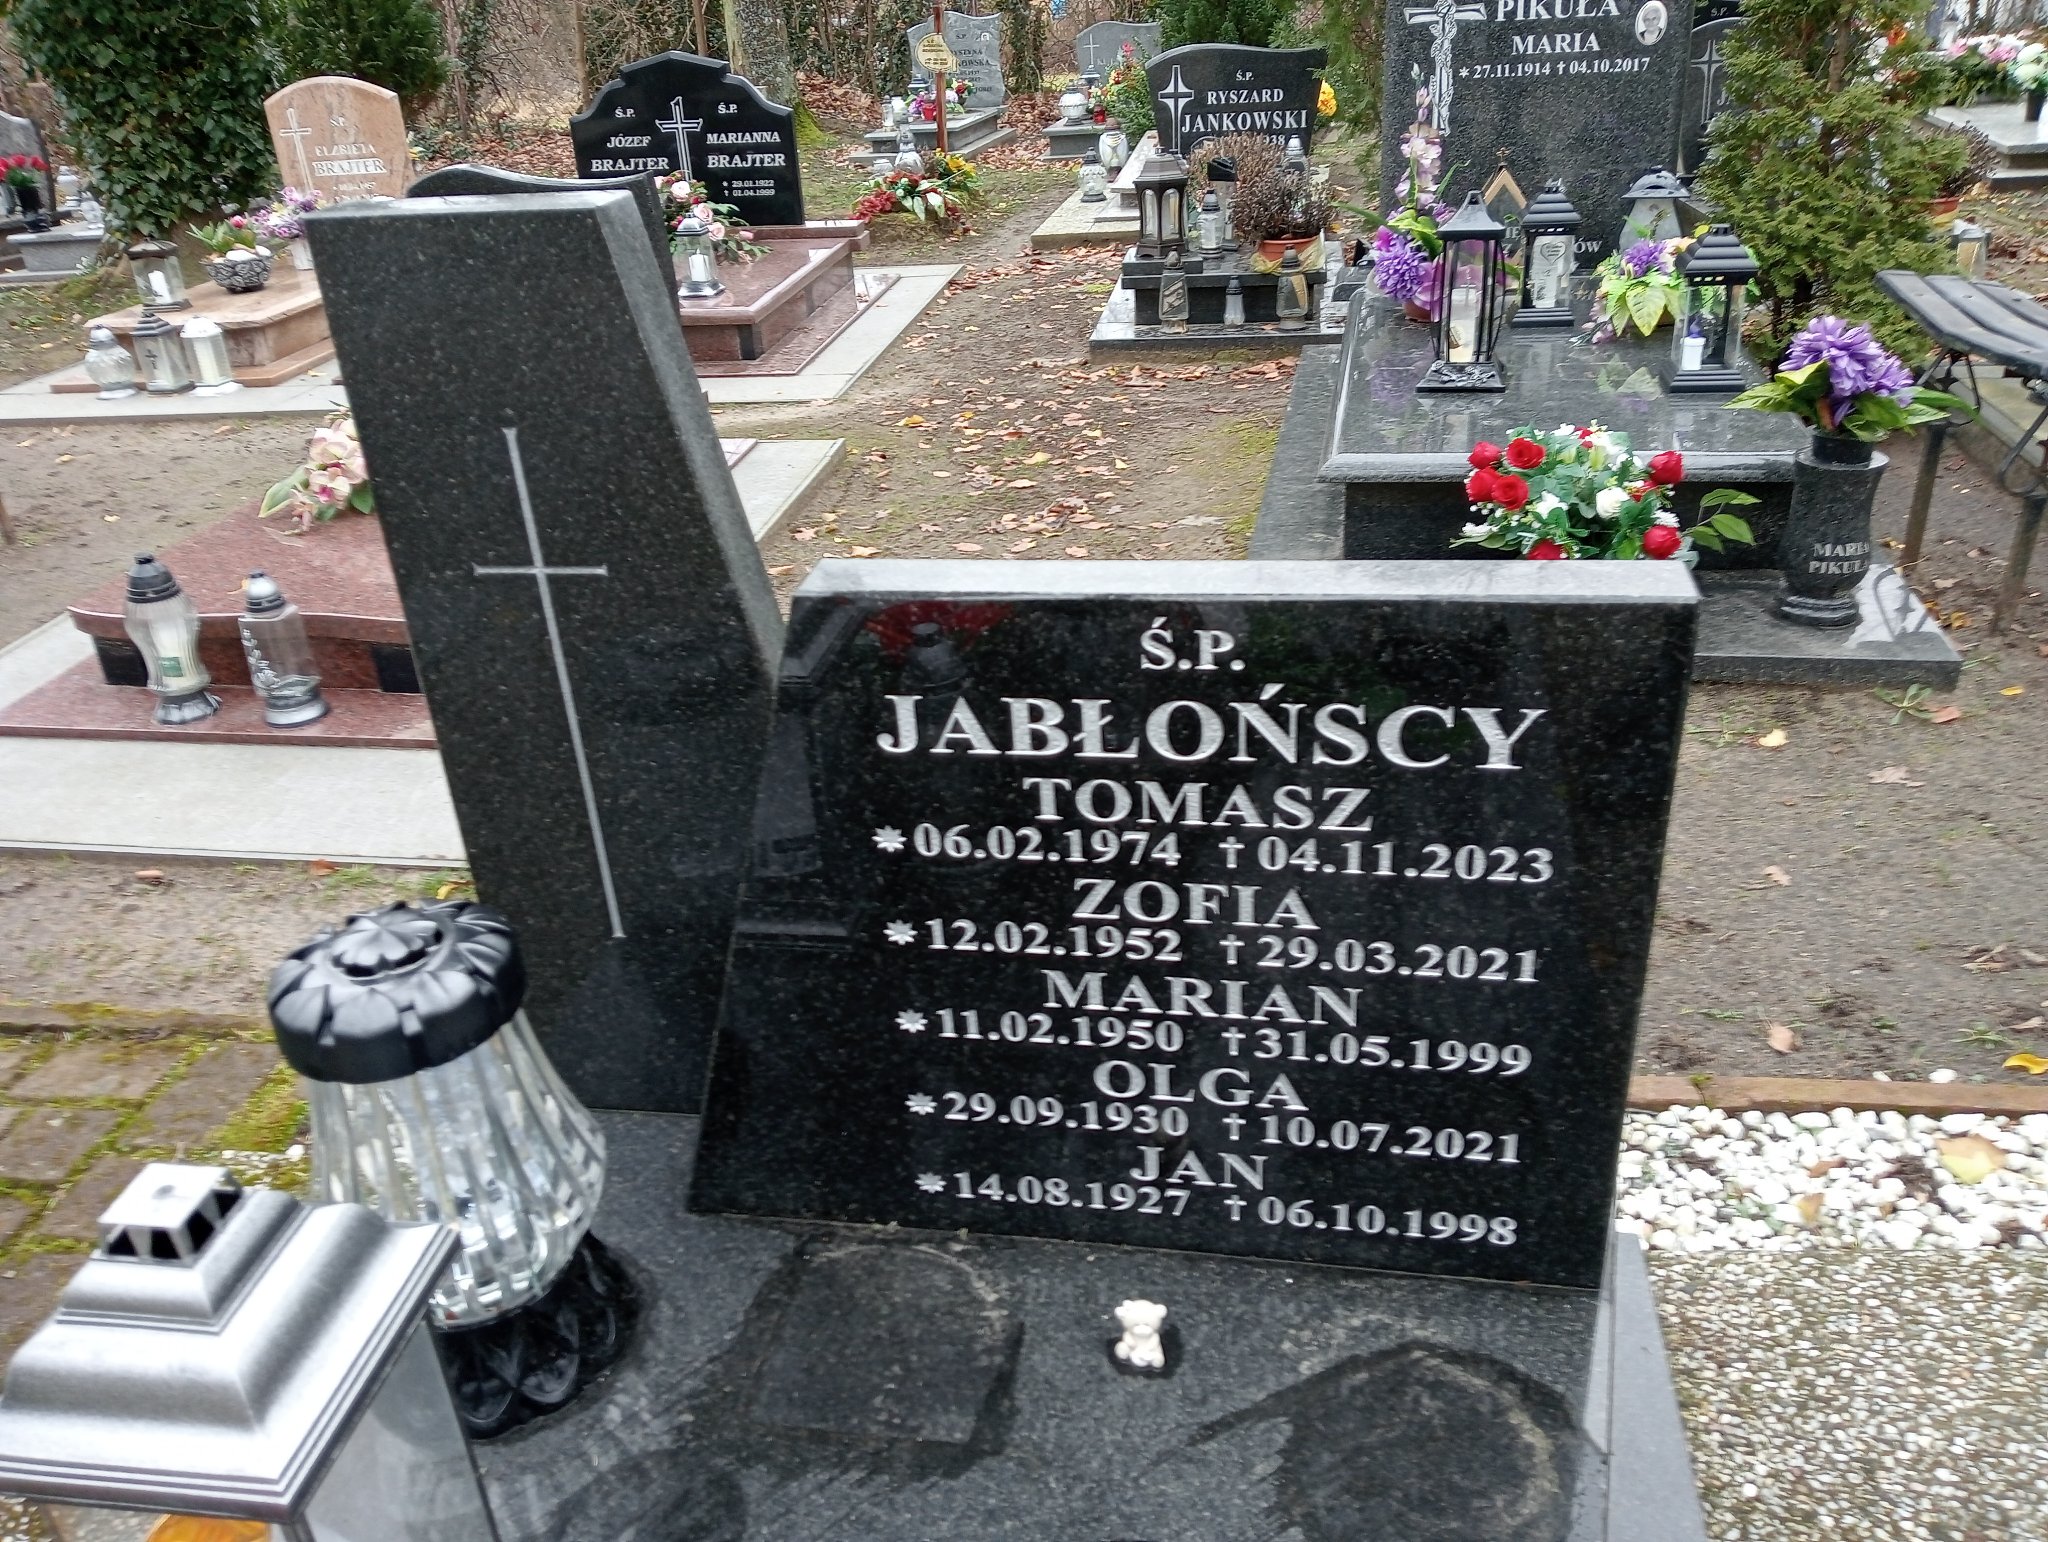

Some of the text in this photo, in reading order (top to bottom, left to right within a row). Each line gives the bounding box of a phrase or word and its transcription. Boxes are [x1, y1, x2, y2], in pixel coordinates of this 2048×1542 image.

[1495, 0, 1620, 21] PIKUŁA
[1511, 32, 1601, 55] MARIA
[1236, 69, 1254, 81] Ś.P.
[1473, 57, 1650, 79] 27.11.1914 04.10.2017
[717, 102, 738, 114] Ś.P.
[1207, 88, 1284, 105] RYSZARD
[614, 106, 636, 118] Ś.P.
[1182, 110, 1307, 133] JANKOWSKI
[606, 133, 651, 148] JÓZEF
[706, 131, 781, 144] MARIANNA
[313, 160, 386, 176] BRAJTER
[591, 157, 669, 172] BRAJTER
[707, 153, 786, 168] BRAJTER
[1140, 617, 1246, 671] Ś.P.
[877, 683, 1548, 770] JABŁOŃSCY
[1022, 777, 1373, 832] TOMASZ
[913, 824, 1554, 883] 06.02.1974 04.11.2023
[1072, 878, 1320, 931] ZOFIA
[926, 918, 1540, 983] 12.02.1952 29.03.2021
[1041, 969, 1364, 1027] MARIAN
[936, 1008, 1533, 1076] 11.02.1950 31.05.1999
[1092, 1060, 1310, 1111] OLGA
[943, 1091, 1521, 1164] 29.09.1930 10.07.2021
[1130, 1146, 1269, 1191] JAN
[954, 1171, 1518, 1246] 14.08.1927 06.10.1998
